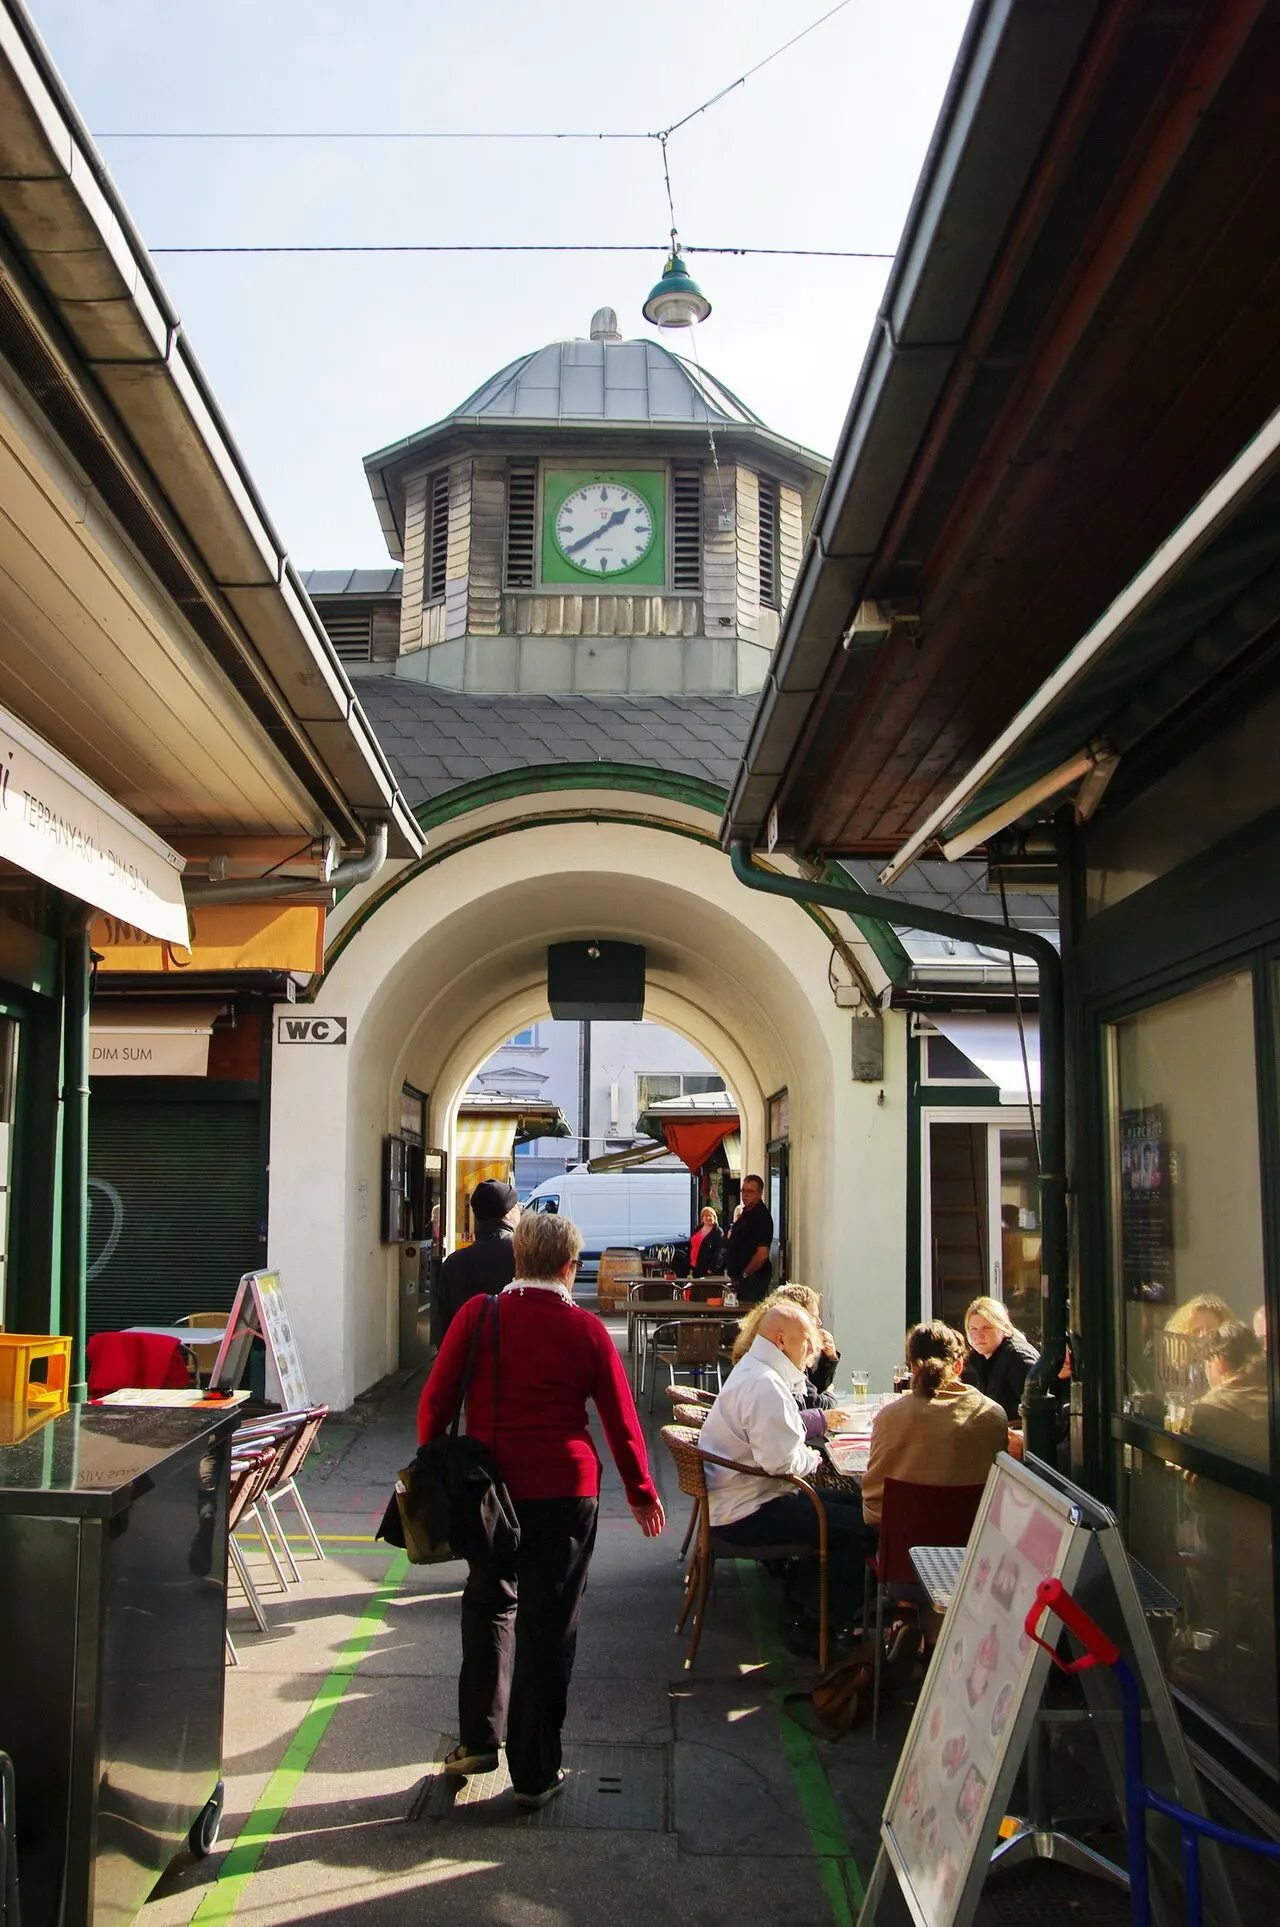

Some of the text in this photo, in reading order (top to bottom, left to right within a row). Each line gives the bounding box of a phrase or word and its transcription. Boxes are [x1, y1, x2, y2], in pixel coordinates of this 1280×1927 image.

[23, 790, 94, 863] TEPPANYAKI
[285, 1021, 330, 1040] WC
[92, 1047, 152, 1060] DIM SUM
